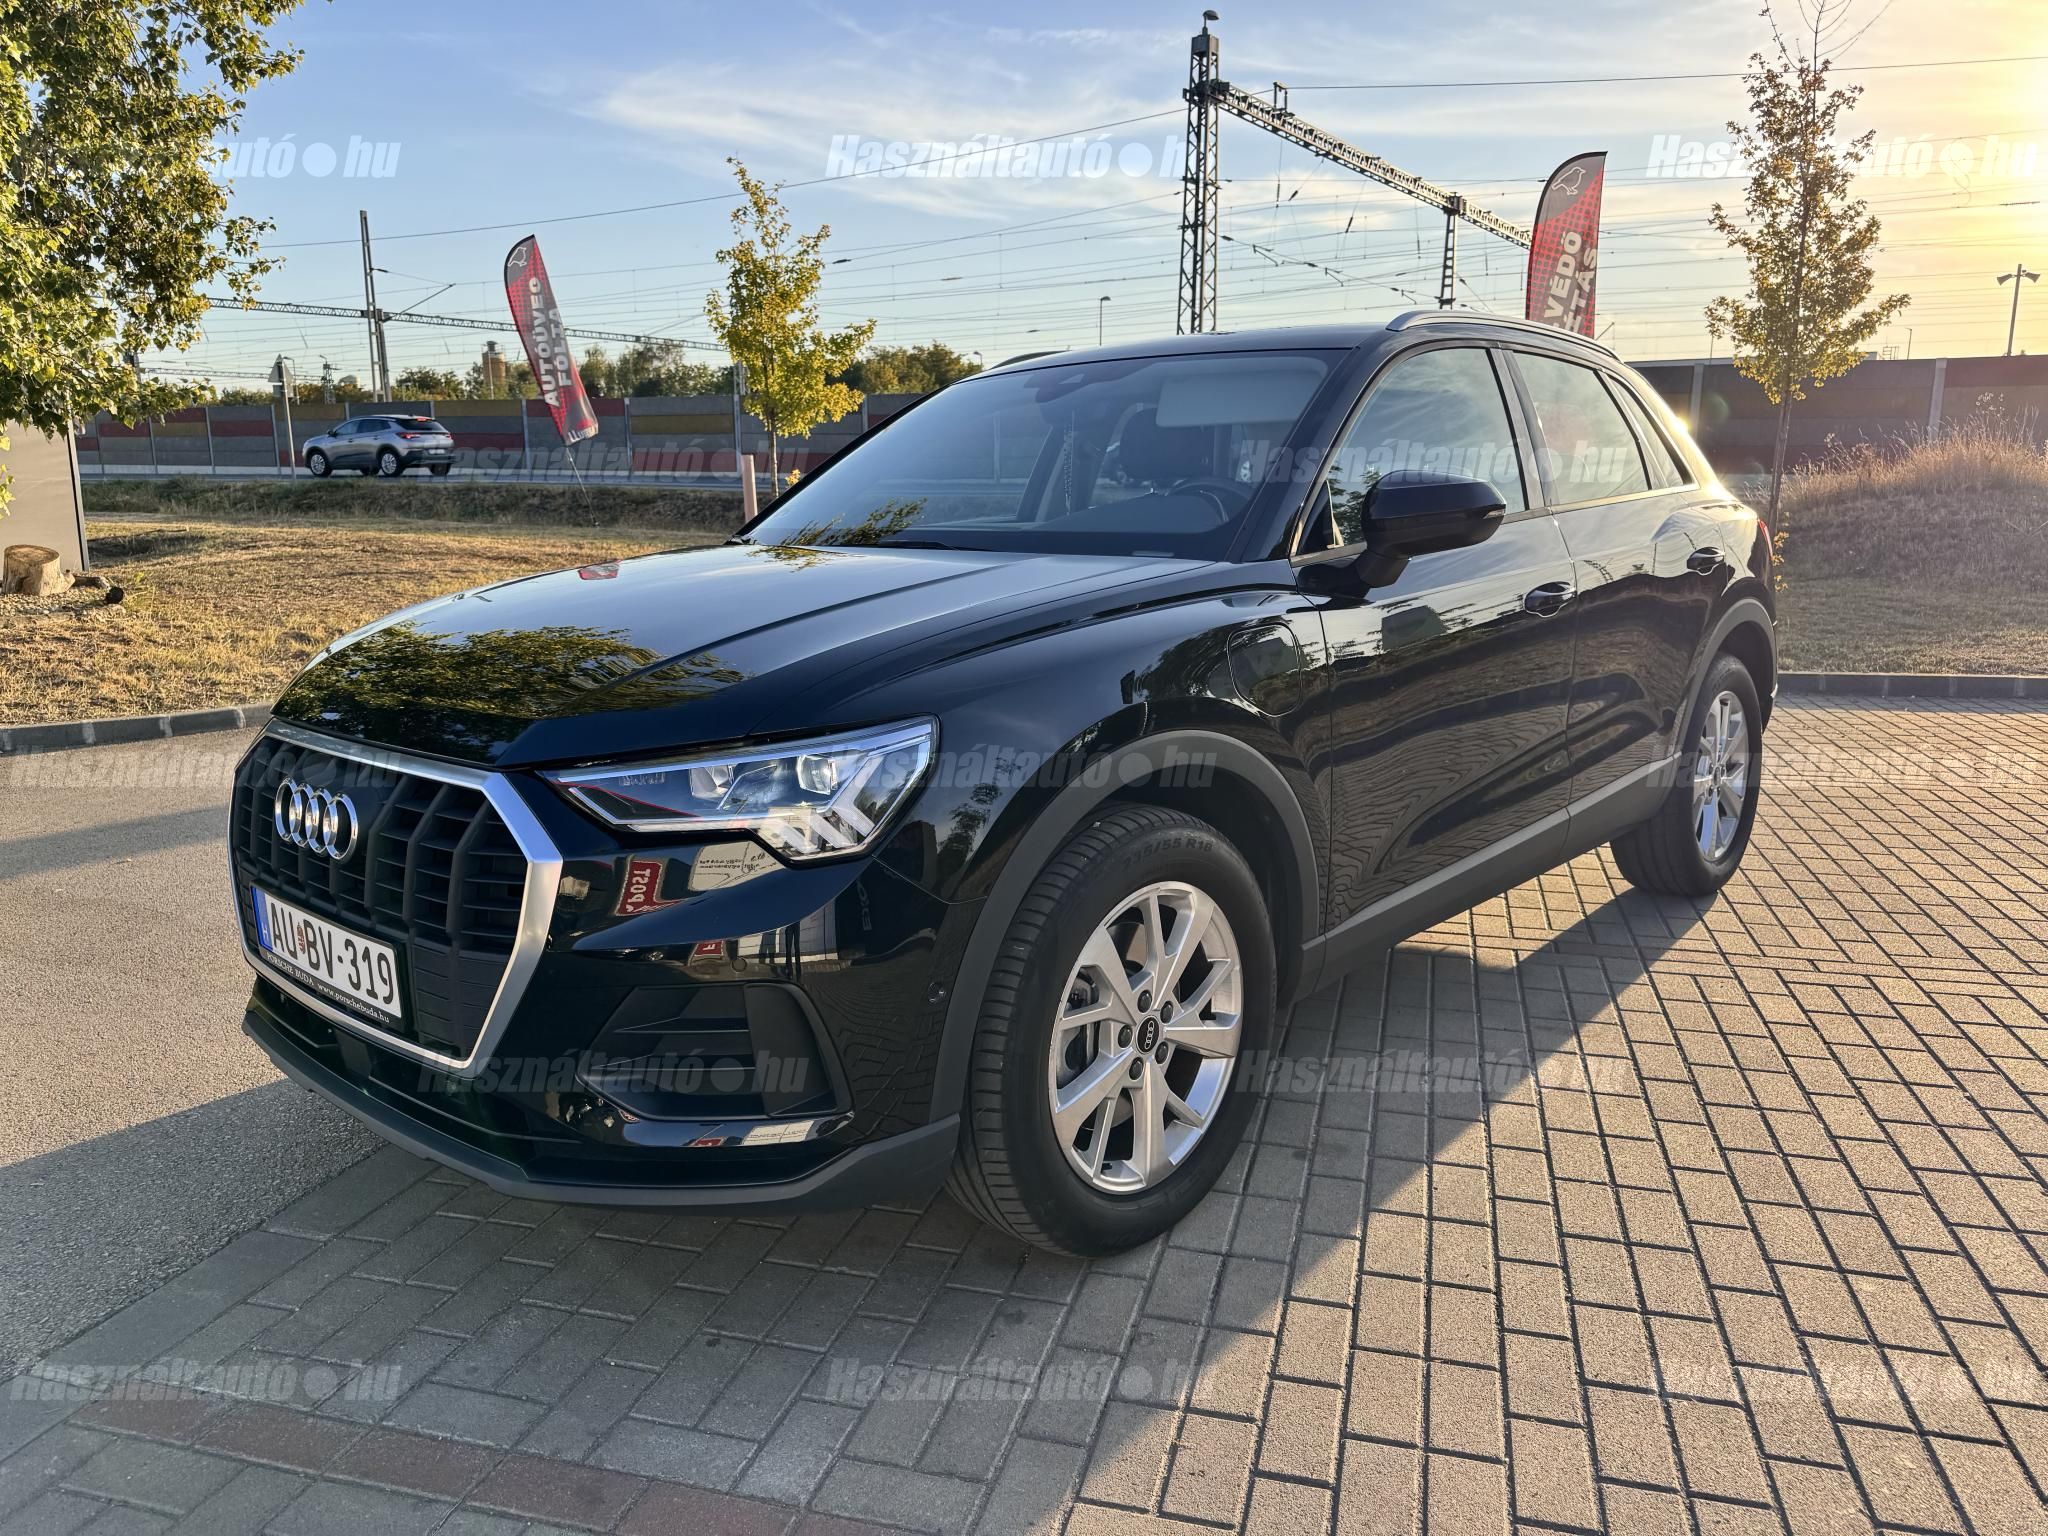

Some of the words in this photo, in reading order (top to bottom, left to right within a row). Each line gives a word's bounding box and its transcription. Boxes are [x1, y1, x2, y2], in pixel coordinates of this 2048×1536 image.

[1186, 838, 1213, 852] R18
[266, 954, 294, 975] PORSCHE
[295, 969, 315, 986] BUDA
[317, 982, 390, 1023] www.porschebuda.hu
